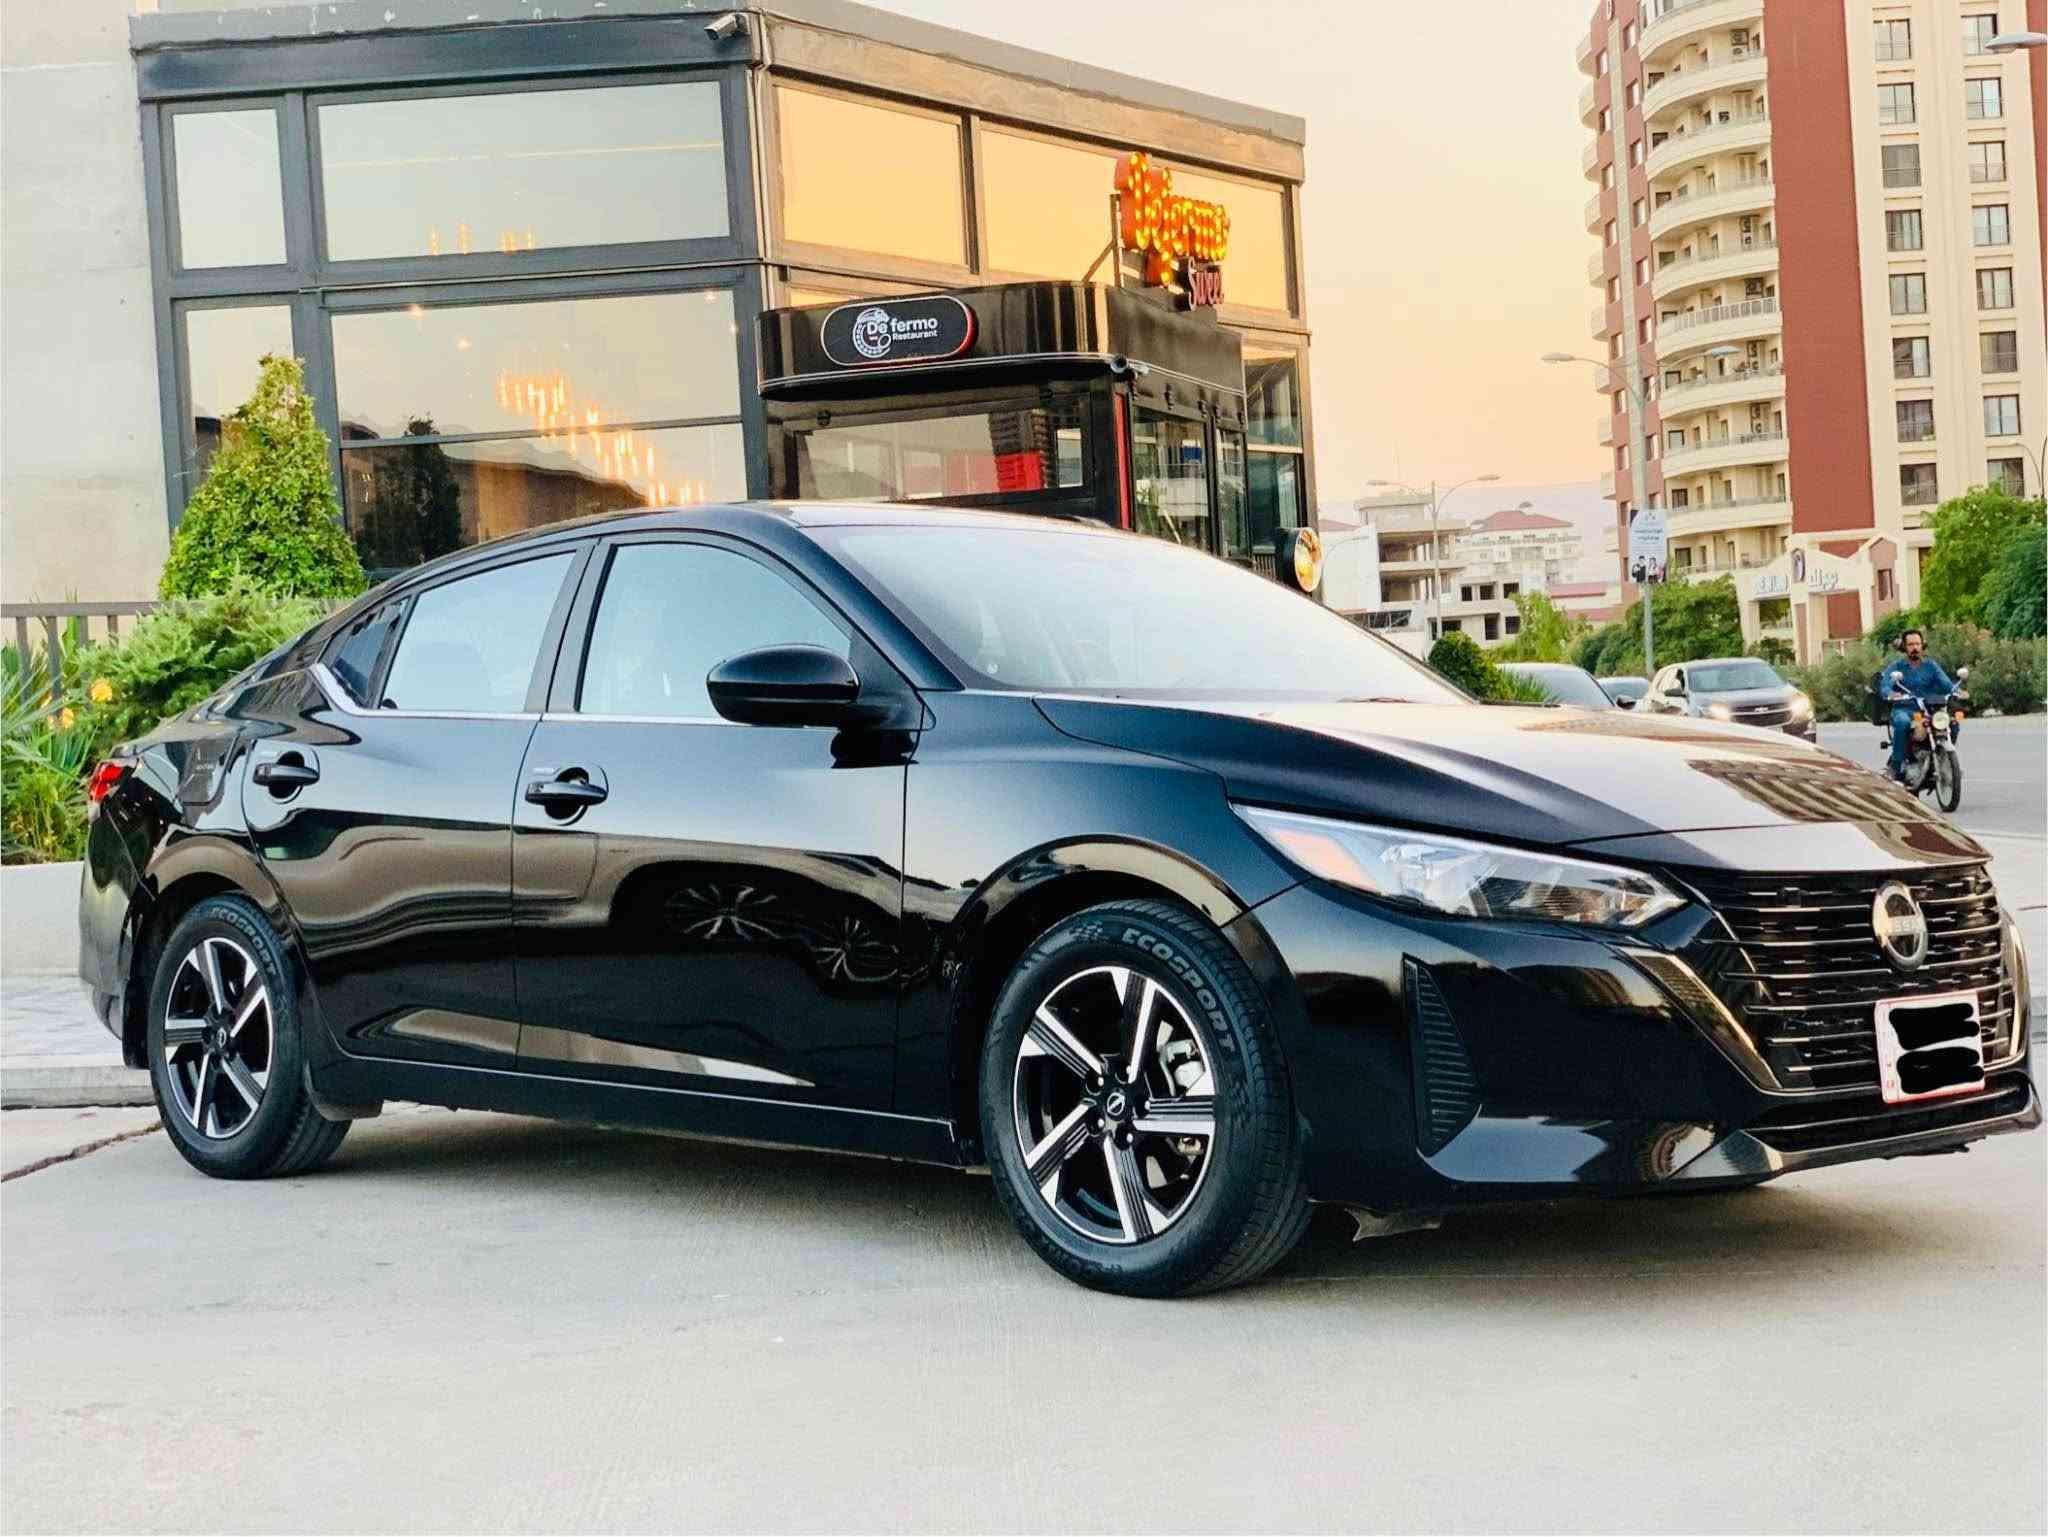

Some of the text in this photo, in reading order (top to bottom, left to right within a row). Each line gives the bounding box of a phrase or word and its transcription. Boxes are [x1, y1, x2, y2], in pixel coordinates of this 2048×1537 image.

[867, 317, 938, 335] De fermo
[209, 907, 277, 975] ECOSPORT
[1122, 928, 1235, 1051] ECOSPORT
